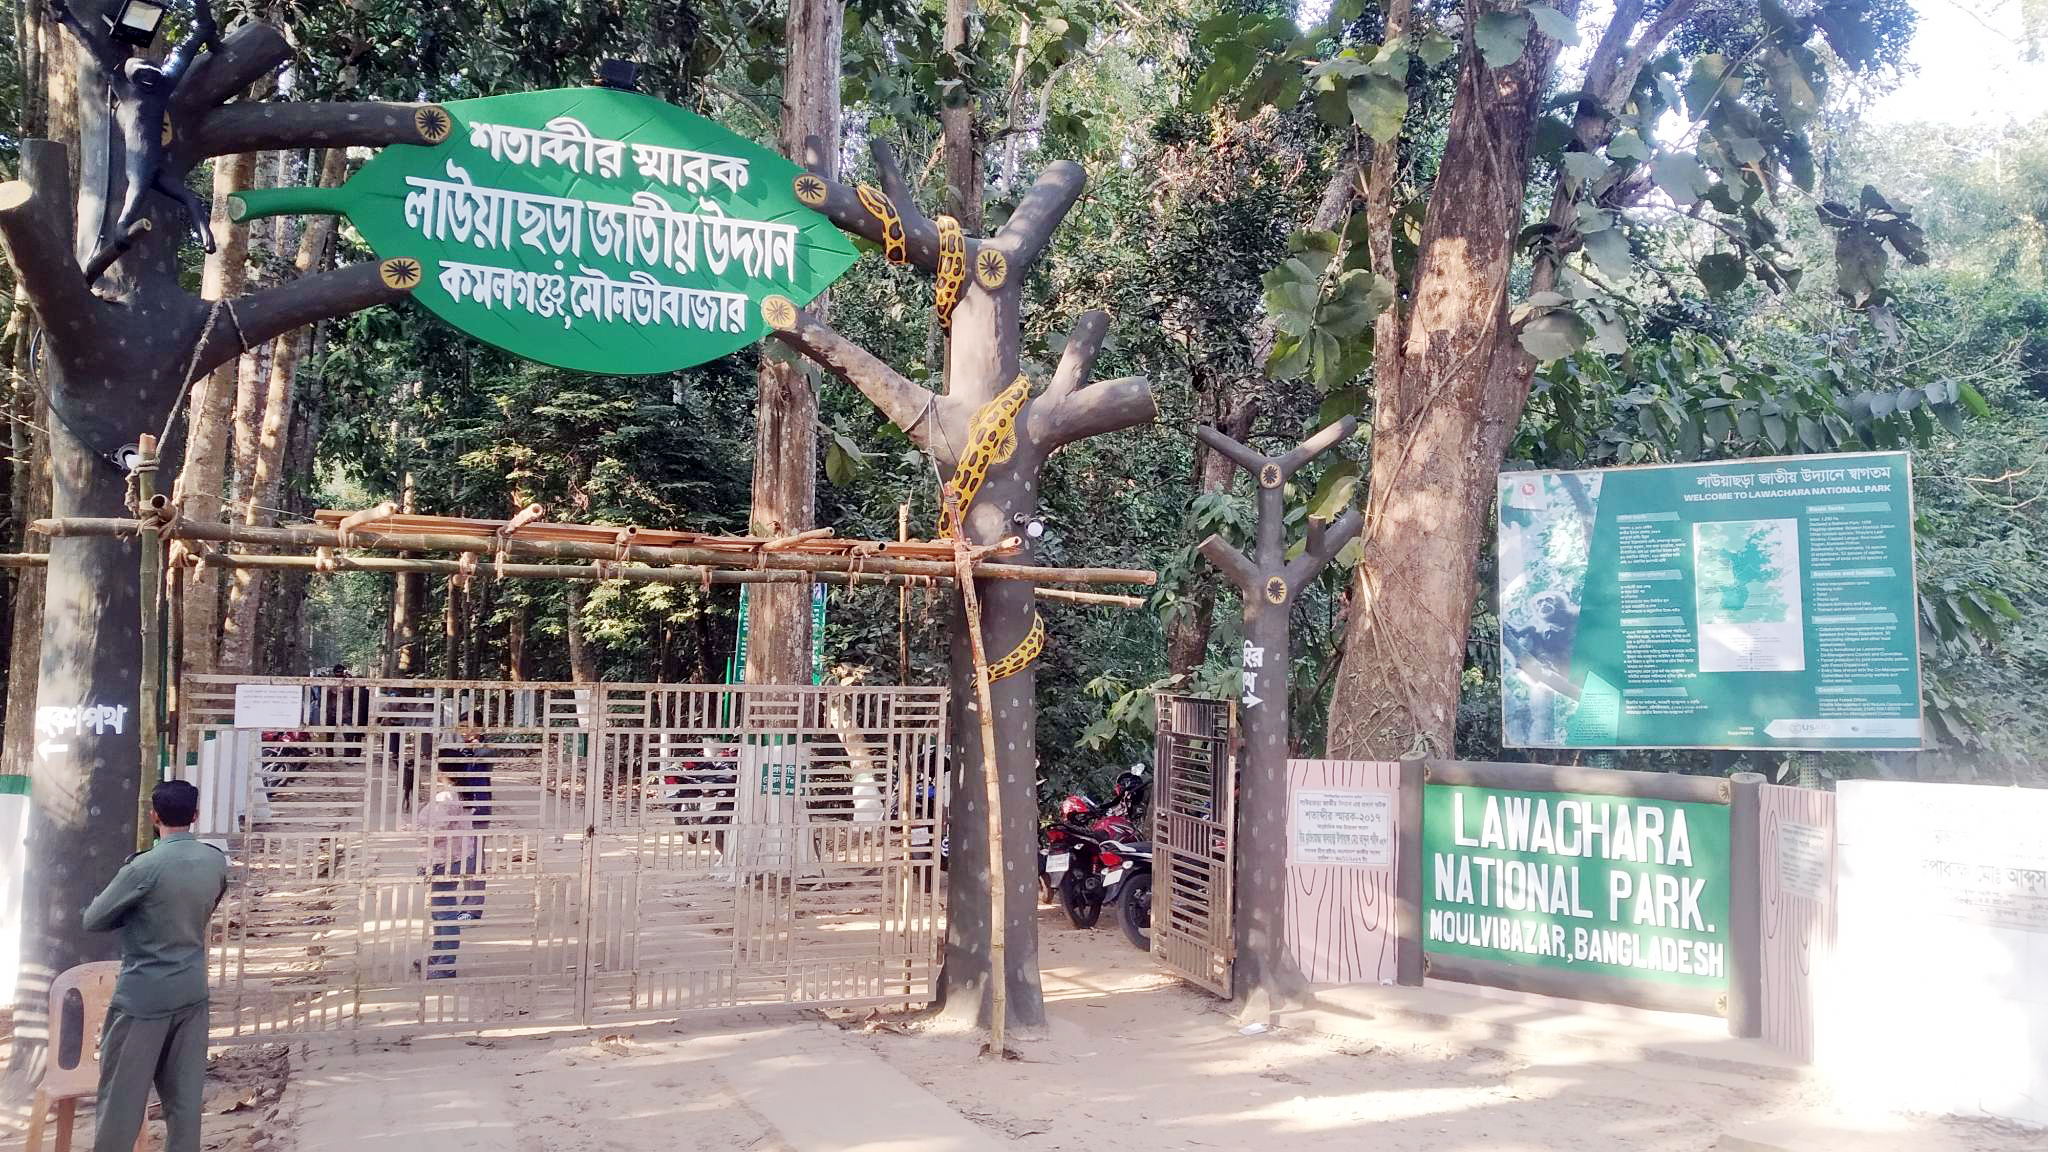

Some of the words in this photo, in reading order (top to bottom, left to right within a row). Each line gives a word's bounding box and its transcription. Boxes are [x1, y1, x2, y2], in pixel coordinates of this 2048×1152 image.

[468, 117, 626, 179] শতাব্দীর
[631, 143, 750, 194] স্মারক
[404, 158, 584, 270] লাউয়াছড়া
[585, 191, 700, 275] জাতীয়
[699, 196, 799, 283] উদ্যান
[1683, 492, 1733, 502] WELCOME
[1734, 491, 1747, 500] TO
[1748, 488, 1811, 499] LAWACHARA
[1812, 485, 1863, 496] NATIONAL
[1864, 484, 1891, 493] PARK
[1695, 472, 1755, 489] লাউয়াছড়া
[1757, 468, 1798, 486] জাতীয়
[1799, 467, 1845, 483] উদ্যানে
[1846, 466, 1891, 481] স্বাগতম
[1453, 792, 1693, 867] LAWACHARA
[1434, 852, 1593, 919] NATIONAL
[1609, 870, 1716, 933] PARK.
